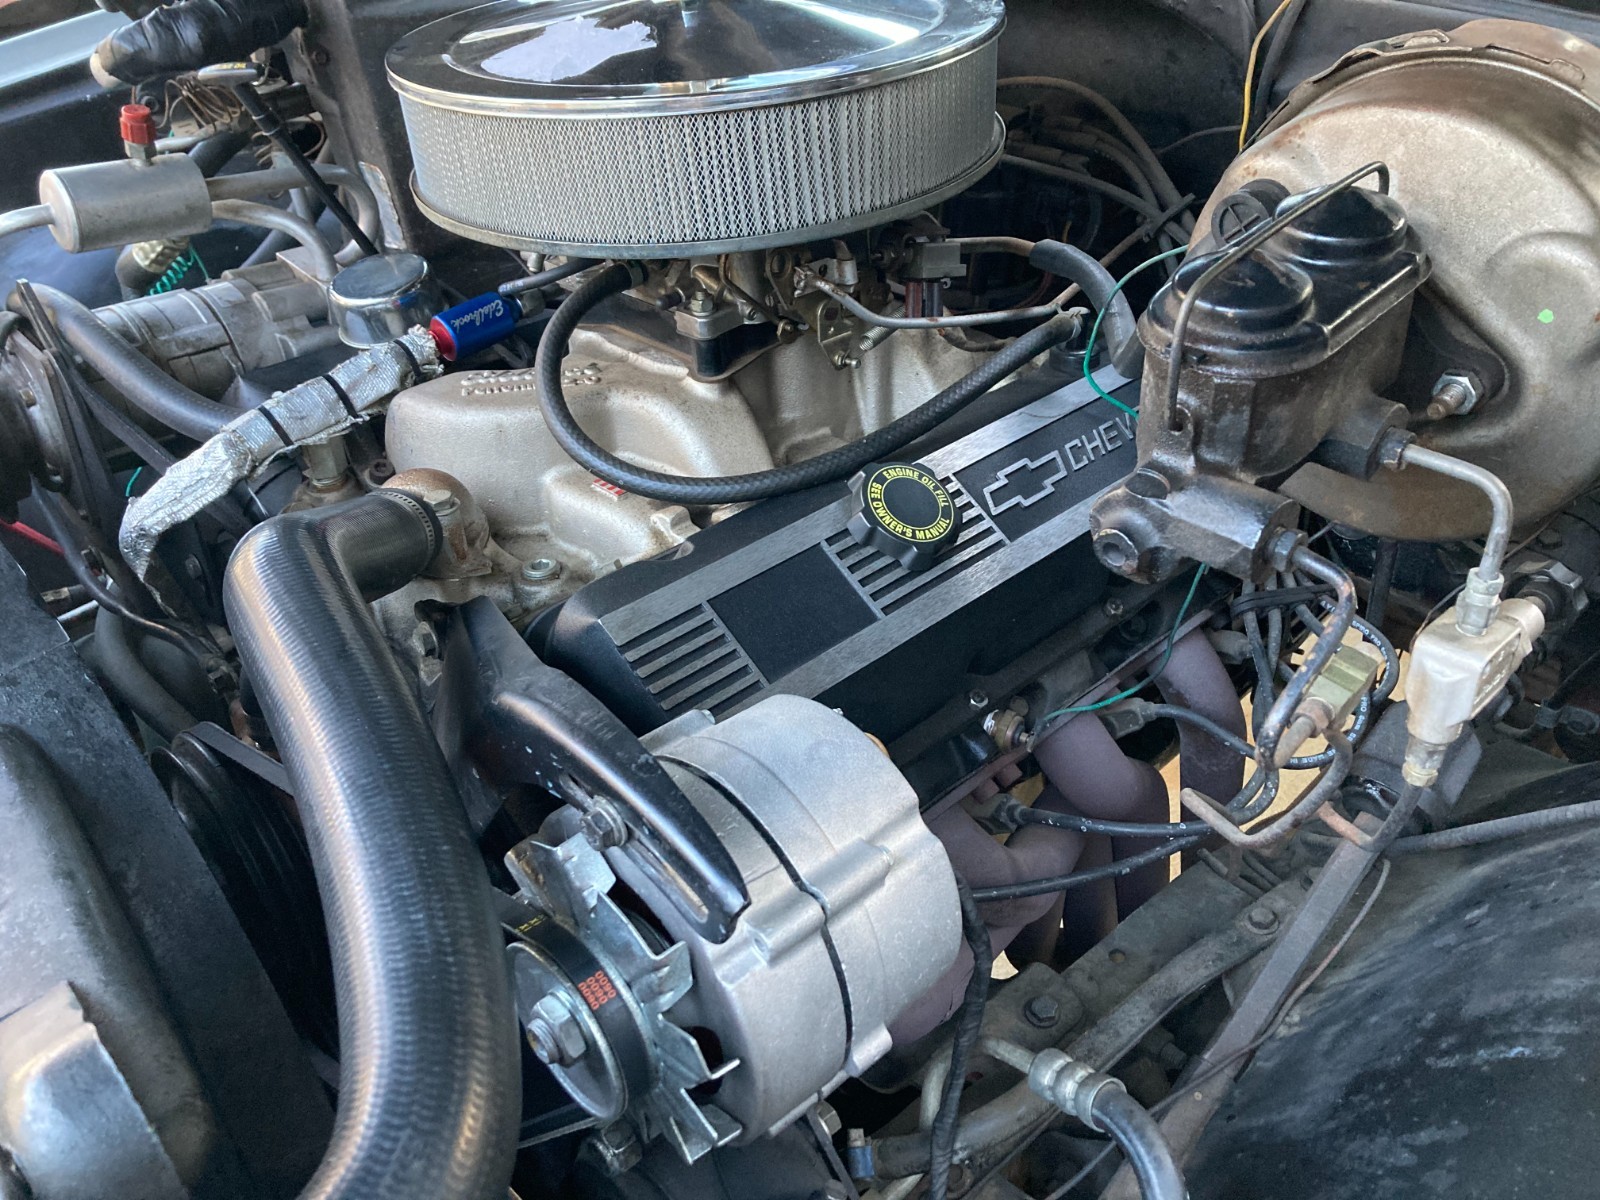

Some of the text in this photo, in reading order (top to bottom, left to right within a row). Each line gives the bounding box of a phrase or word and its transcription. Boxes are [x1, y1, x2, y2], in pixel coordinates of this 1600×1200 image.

[450, 299, 504, 334] Edelbrock
[1064, 411, 1135, 472] CHEV
[882, 467, 949, 508] ENGINE OIL FILL
[870, 481, 950, 540] SEE OWNER'S MANUAL
[1370, 633, 1382, 647] PRO
[1360, 695, 1368, 713] PRO
[1301, 753, 1325, 764] MADE
